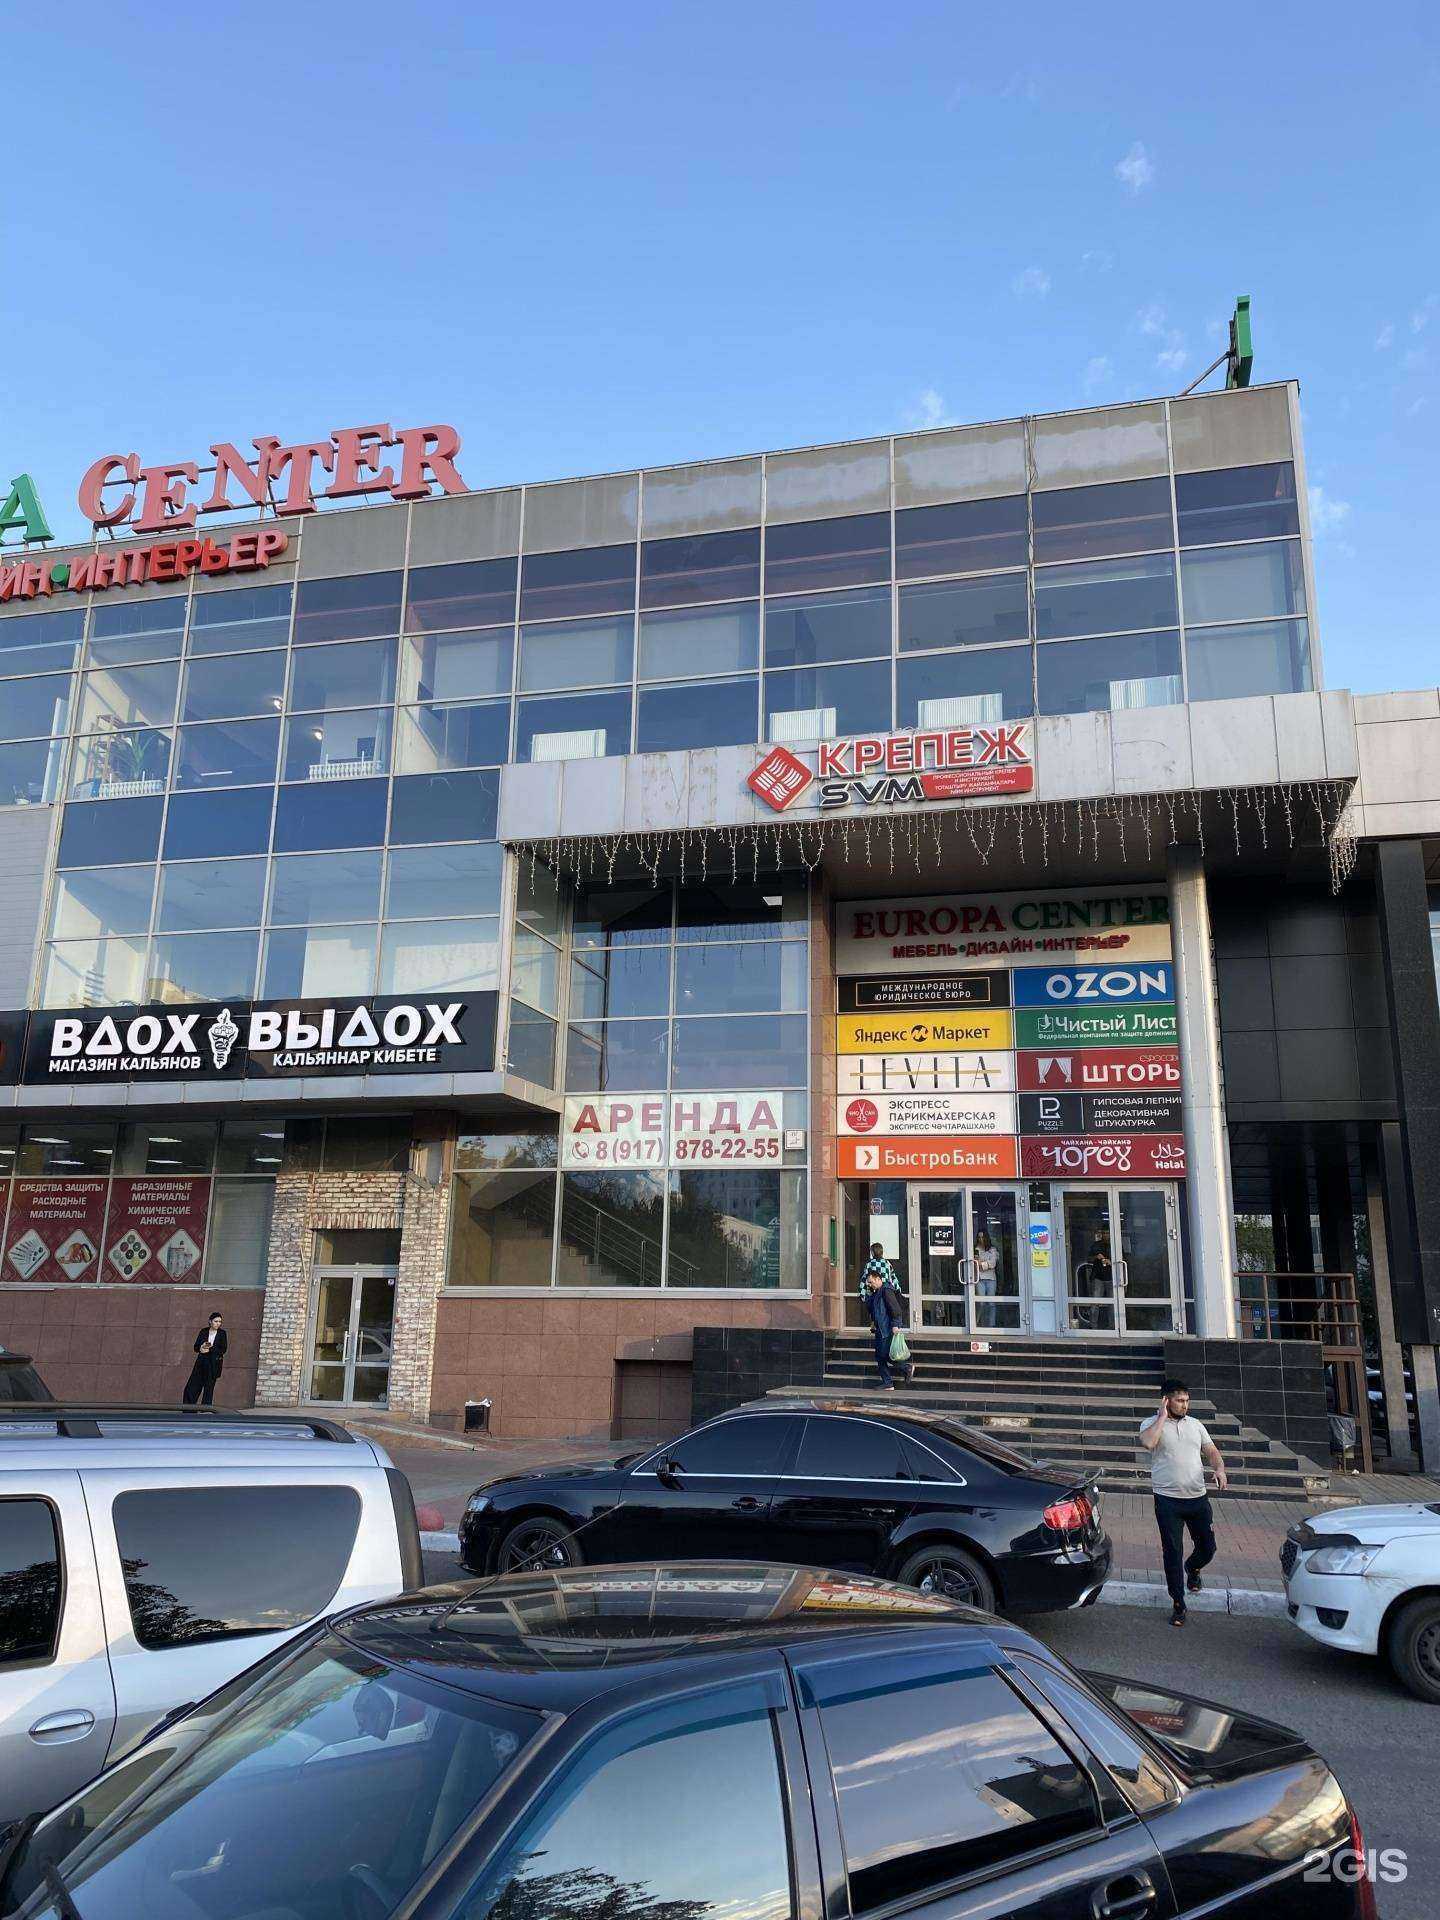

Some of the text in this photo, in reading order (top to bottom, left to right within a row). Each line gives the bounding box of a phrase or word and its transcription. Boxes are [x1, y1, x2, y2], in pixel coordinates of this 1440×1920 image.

[78, 423, 470, 534] CENTER
[68, 529, 288, 592] ИНТЕРЬЕР
[818, 724, 1031, 779] КРЕПЕЖ
[820, 775, 925, 808] SVM
[853, 896, 1170, 938] EUROPA CENTER
[893, 934, 1132, 959] МЕБЕЛЬ ДИЗАЙН ИНТЕРЬЕР
[881, 982, 963, 992] МЕЖДУНАРОДНОЕ
[1046, 970, 1167, 999] OZON
[875, 990, 971, 1001] ЮРИДИЧЕСКОЕ БЮРО
[51, 1003, 464, 1056] ВДОХ ВЫДОХ
[1056, 1014, 1177, 1032] Чистый Лист
[855, 1026, 990, 1043] Яндекс Маркет
[49, 1056, 201, 1072] МАГАЗИН КАЛЬЯНОВ
[273, 1048, 437, 1066] КАЛЬЯННАР КИБЕТЕ
[859, 1056, 992, 1090] LEVITA
[889, 1101, 950, 1109] ЭКСПРЕСС
[1093, 1096, 1182, 1105] ГИПСОВАЯ ЛЕПНИ
[573, 1101, 778, 1134] АРЕНДА
[889, 1112, 996, 1121] ПАРИКМАХЕРСКАЯ
[1094, 1109, 1169, 1118] ДЕКОРАТИВНАЯ
[1095, 1119, 1155, 1127] ШТУКАТУРКА
[675, 1138, 779, 1159] 878-22-55
[885, 1150, 998, 1169] БыстроБанк
[1156, 1161, 1184, 1169] Halal
[20, 1184, 103, 1192] СРЕДСТВА ЗАЩИТЫ
[131, 1183, 192, 1191] АБРАЗИВНЫЕ
[33, 1197, 87, 1206] РАСХОДНЫЕ
[128, 1206, 191, 1214] ХИМИЧЕСКИЕ
[30, 1210, 86, 1219] МАТЕРИАЛЫ
